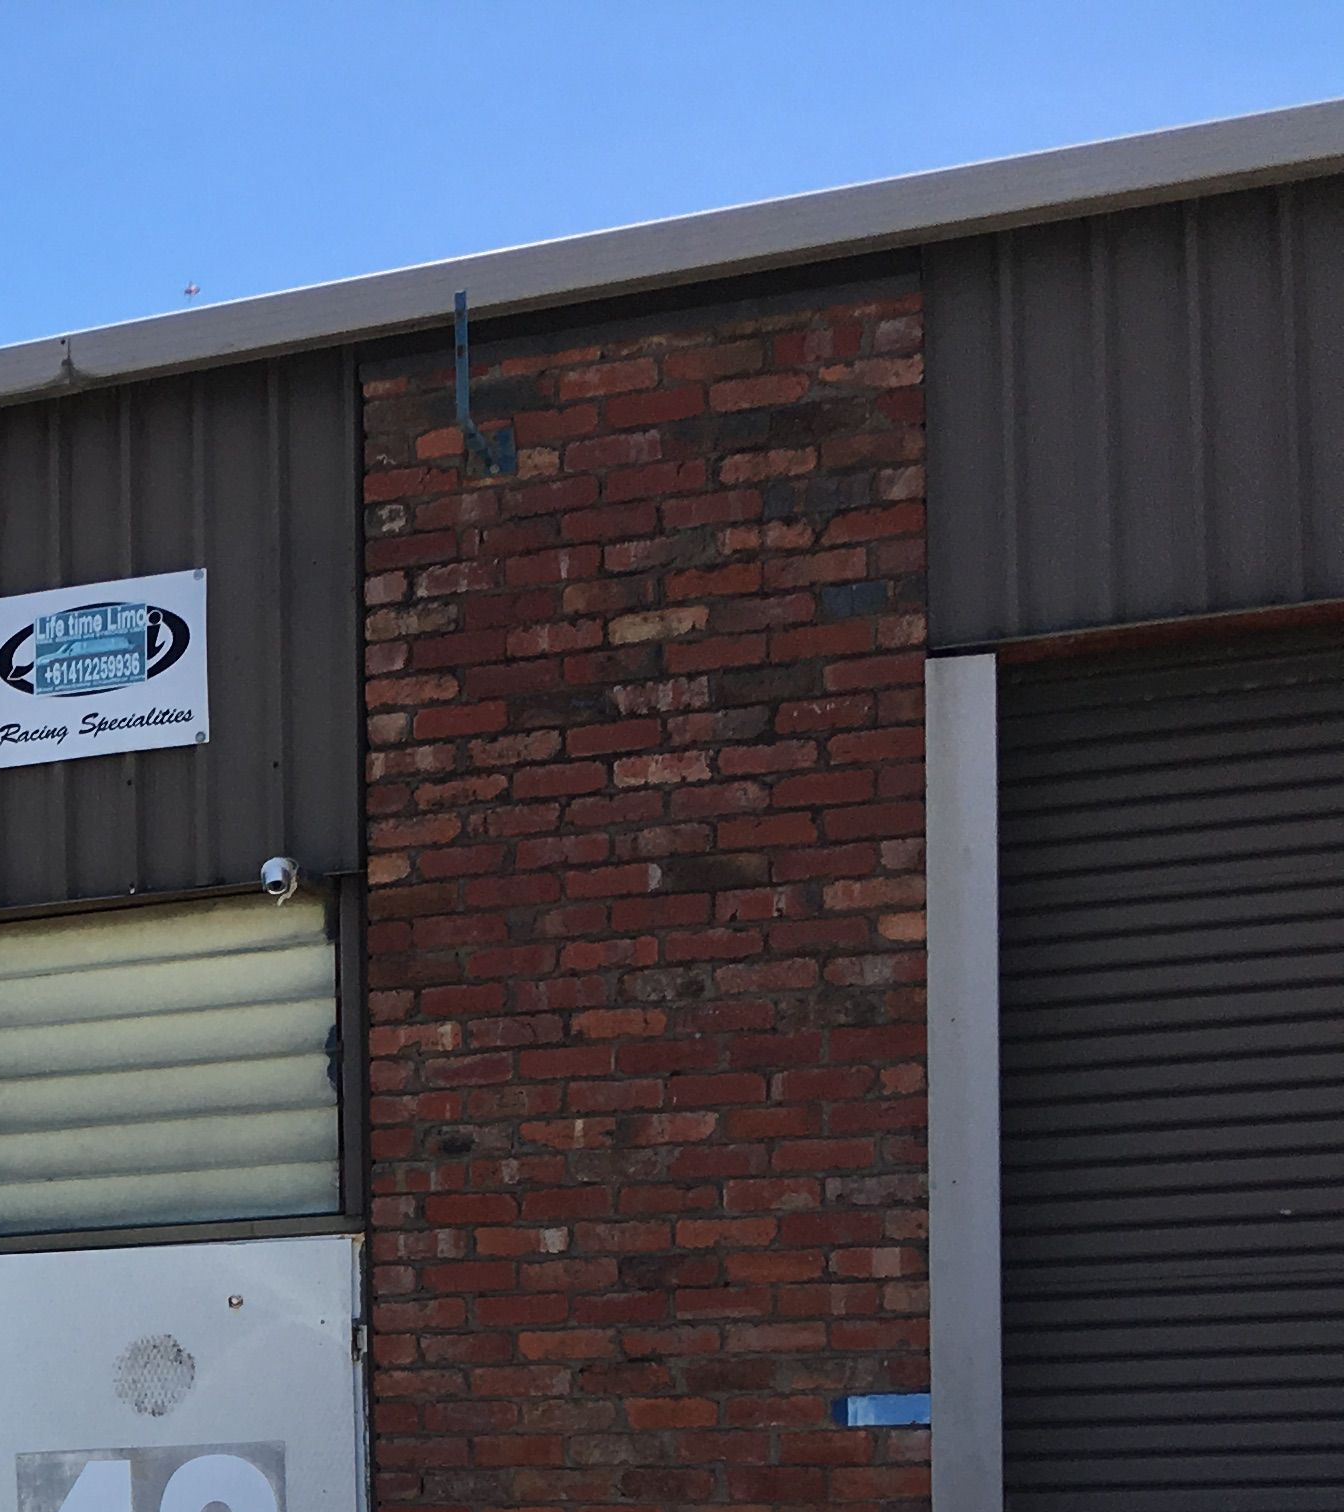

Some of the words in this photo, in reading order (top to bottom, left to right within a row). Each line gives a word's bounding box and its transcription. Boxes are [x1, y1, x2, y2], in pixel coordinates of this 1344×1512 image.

[37, 617, 64, 640] Life
[68, 614, 102, 635] time
[107, 607, 146, 630] Limo
[45, 653, 140, 684] +61412259936
[0, 723, 68, 746] Racing
[79, 708, 194, 737] Specialities
